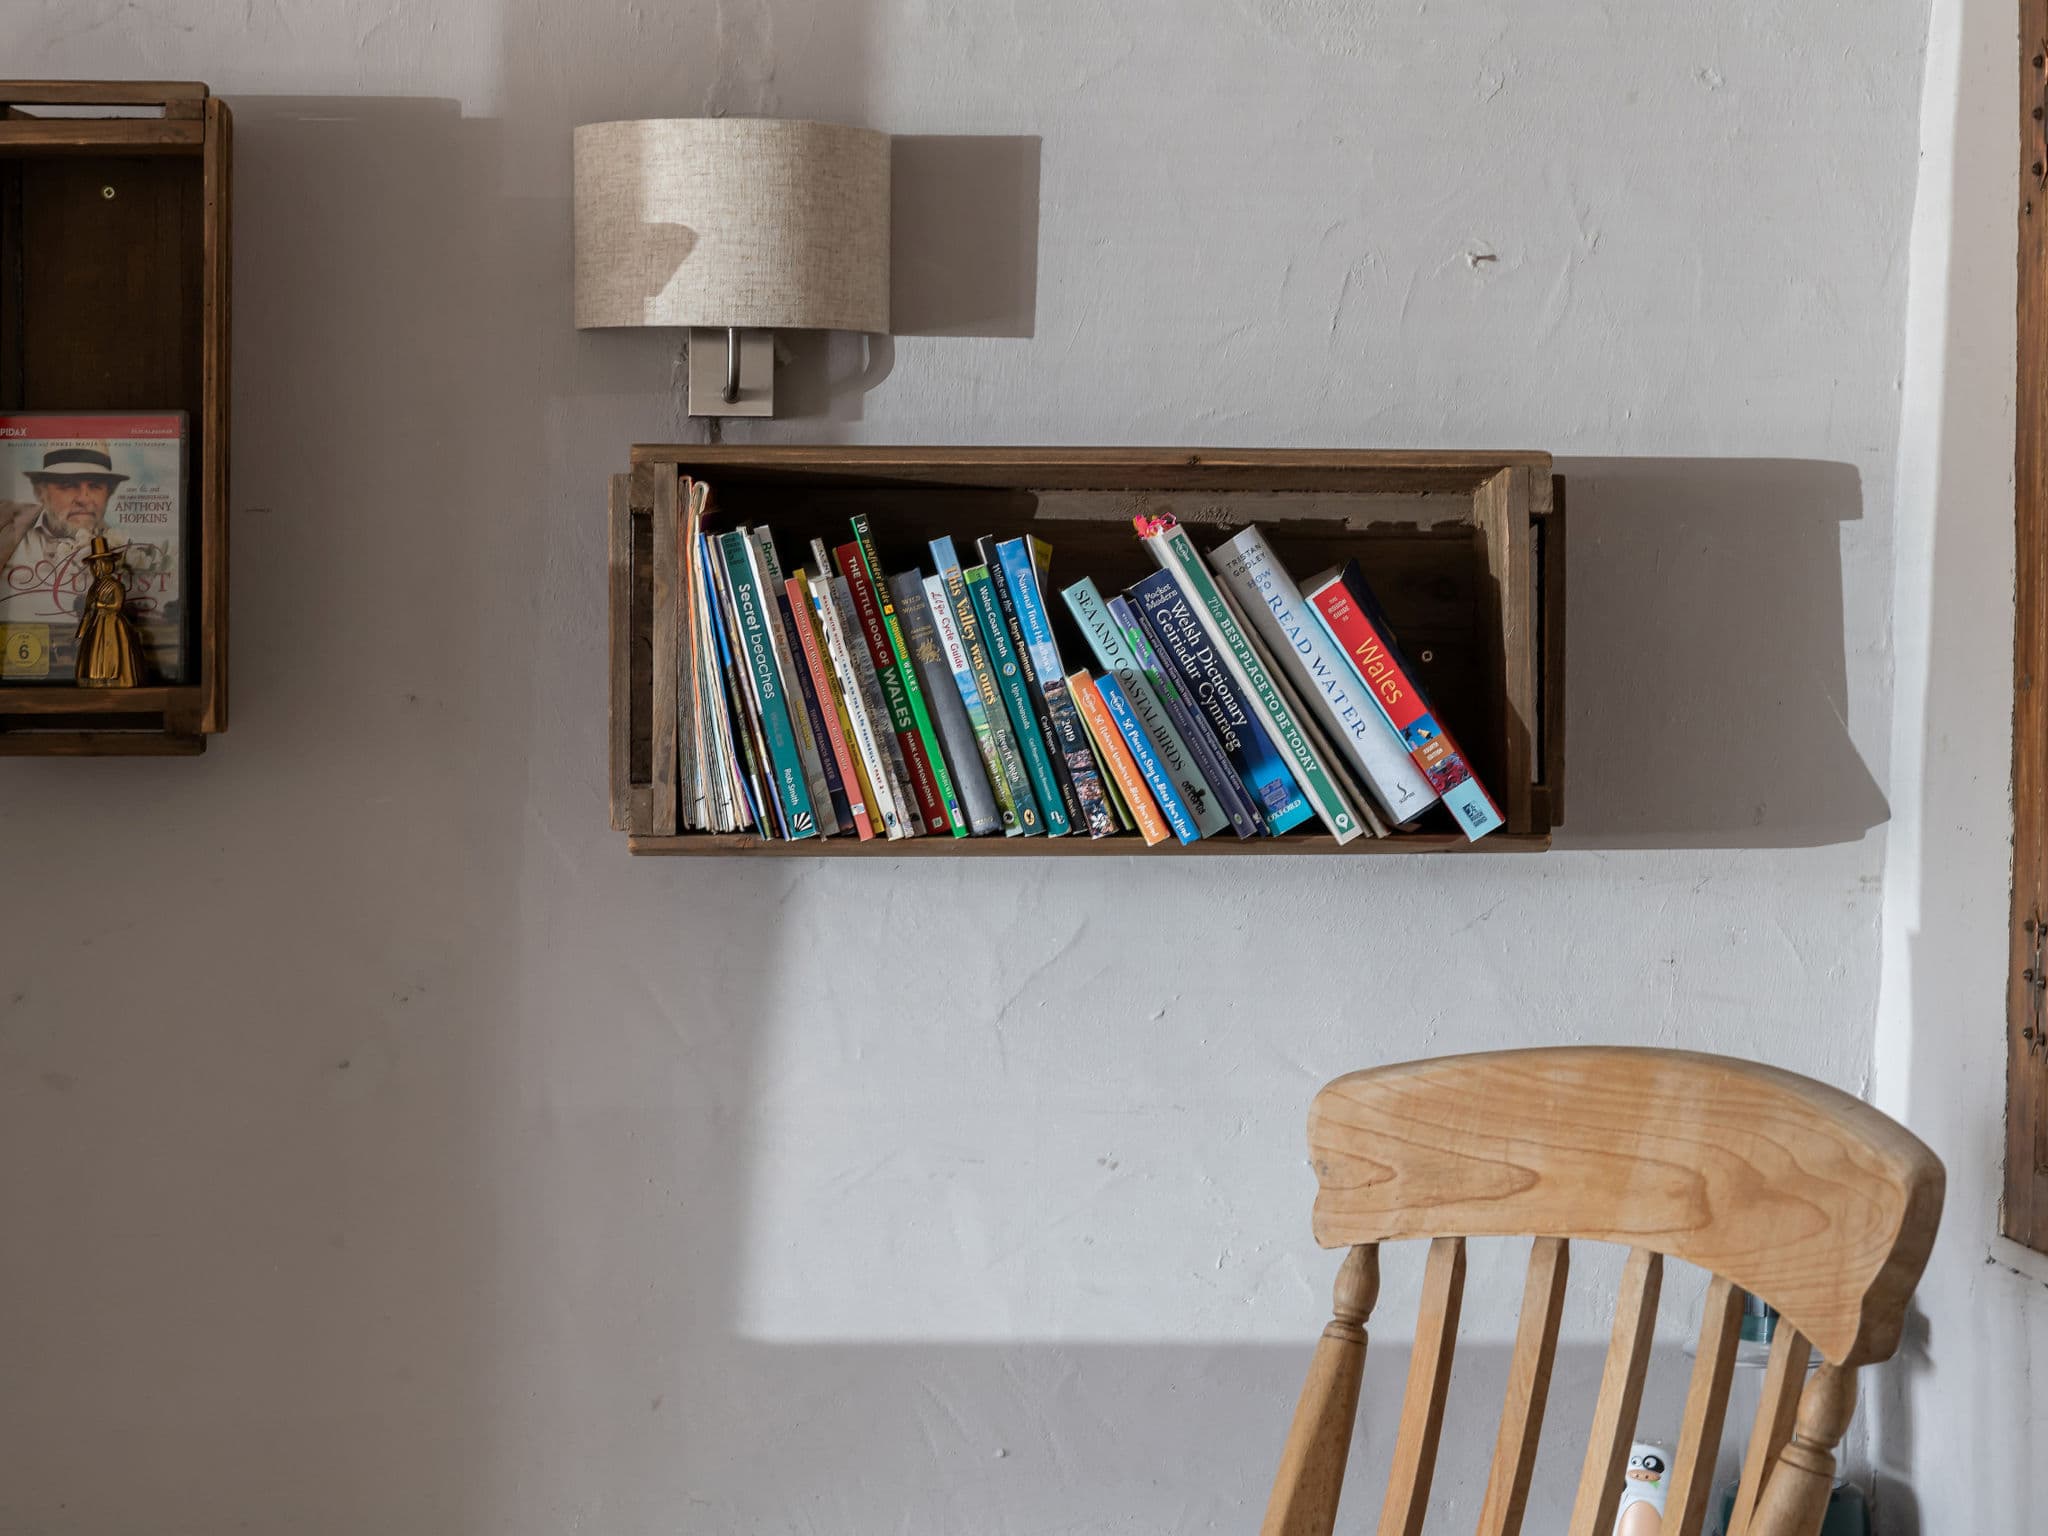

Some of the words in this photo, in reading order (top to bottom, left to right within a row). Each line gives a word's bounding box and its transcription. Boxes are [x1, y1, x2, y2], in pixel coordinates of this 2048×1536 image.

[0, 427, 27, 437] PIDAX
[115, 501, 173, 511] ANTHONY
[119, 513, 168, 523] HOPKINS
[855, 520, 868, 534] 10
[760, 541, 779, 576] Bradt
[847, 555, 862, 579] THE
[1226, 543, 1264, 568] TRISTAN
[1232, 552, 1266, 577] GOOLEY
[861, 537, 883, 580] pathfinder
[875, 580, 890, 603] guide
[944, 563, 965, 597] This
[991, 563, 1005, 587] Walks
[1247, 567, 1272, 589] HOW
[855, 579, 874, 616] LITTLE
[999, 587, 1008, 599] on
[1016, 572, 1034, 609] National
[1143, 580, 1172, 602] Pocket
[1144, 586, 1178, 611] Modern
[820, 594, 831, 615] WALKS
[1002, 599, 1013, 613] the
[827, 616, 836, 631] WITH
[951, 597, 978, 642] Valley
[978, 585, 994, 611] Wales
[986, 611, 1002, 636] Coast
[994, 636, 1008, 657] Path
[1027, 609, 1041, 630] Trust
[737, 582, 760, 631] Secret
[749, 632, 776, 699] beaches
[867, 616, 884, 649] BOOK
[940, 616, 955, 641] Cycle
[949, 642, 965, 669] Guide
[19, 644, 29, 659] 6
[832, 633, 844, 657] HISTORY
[888, 617, 909, 659] Snowdonia
[902, 660, 919, 692] WALES
[968, 642, 985, 670] was
[1033, 630, 1054, 673] Handbook
[877, 649, 890, 666] OF
[1014, 640, 1034, 682] Peninsula
[1167, 598, 1205, 646] Welsh
[1194, 645, 1251, 730] Dictionary
[1267, 593, 1313, 656] READ
[1309, 656, 1371, 740] WATER
[1073, 588, 1099, 621] SEA
[1091, 618, 1121, 657] AND
[1111, 655, 1160, 728] COASTAL
[1151, 724, 1186, 772] BIRDS
[1152, 606, 1206, 681] Geiriadur
[1191, 679, 1247, 753] Cymraeg
[1356, 637, 1403, 705] Wales
[849, 686, 856, 695] ON
[978, 671, 996, 705] ours
[1206, 595, 1227, 619] The
[1220, 618, 1244, 651] BEST
[1239, 649, 1269, 692] PLACE
[1262, 690, 1281, 712] TO
[1274, 710, 1291, 729] BE
[1284, 728, 1317, 774] TODAY
[852, 696, 860, 709] THE
[882, 666, 912, 728] WALES
[1015, 696, 1031, 729] Peninsula
[1039, 714, 1050, 731] Carl
[1093, 713, 1105, 725] 50
[1121, 717, 1134, 731] 50
[905, 731, 916, 752] MARK
[1060, 718, 1076, 742] 2019
[1127, 729, 1146, 753] Places
[861, 728, 877, 763] PENINSULA
[1043, 730, 1058, 755] Rogers
[1139, 750, 1148, 759] to
[988, 759, 998, 773] Phil
[995, 728, 1010, 751] Eileen
[1006, 760, 1021, 782] Webb
[782, 767, 794, 783] Rob
[1139, 757, 1158, 778] Stay
[1152, 774, 1161, 783] to
[1125, 778, 1133, 786] to
[1155, 781, 1172, 802] Blow
[786, 783, 800, 806] Smith
[1136, 801, 1151, 820] Your
[1164, 799, 1181, 820] Your
[1265, 795, 1303, 824] OXFORD
[1143, 818, 1159, 838] Mind
[1173, 817, 1191, 839] Mind
